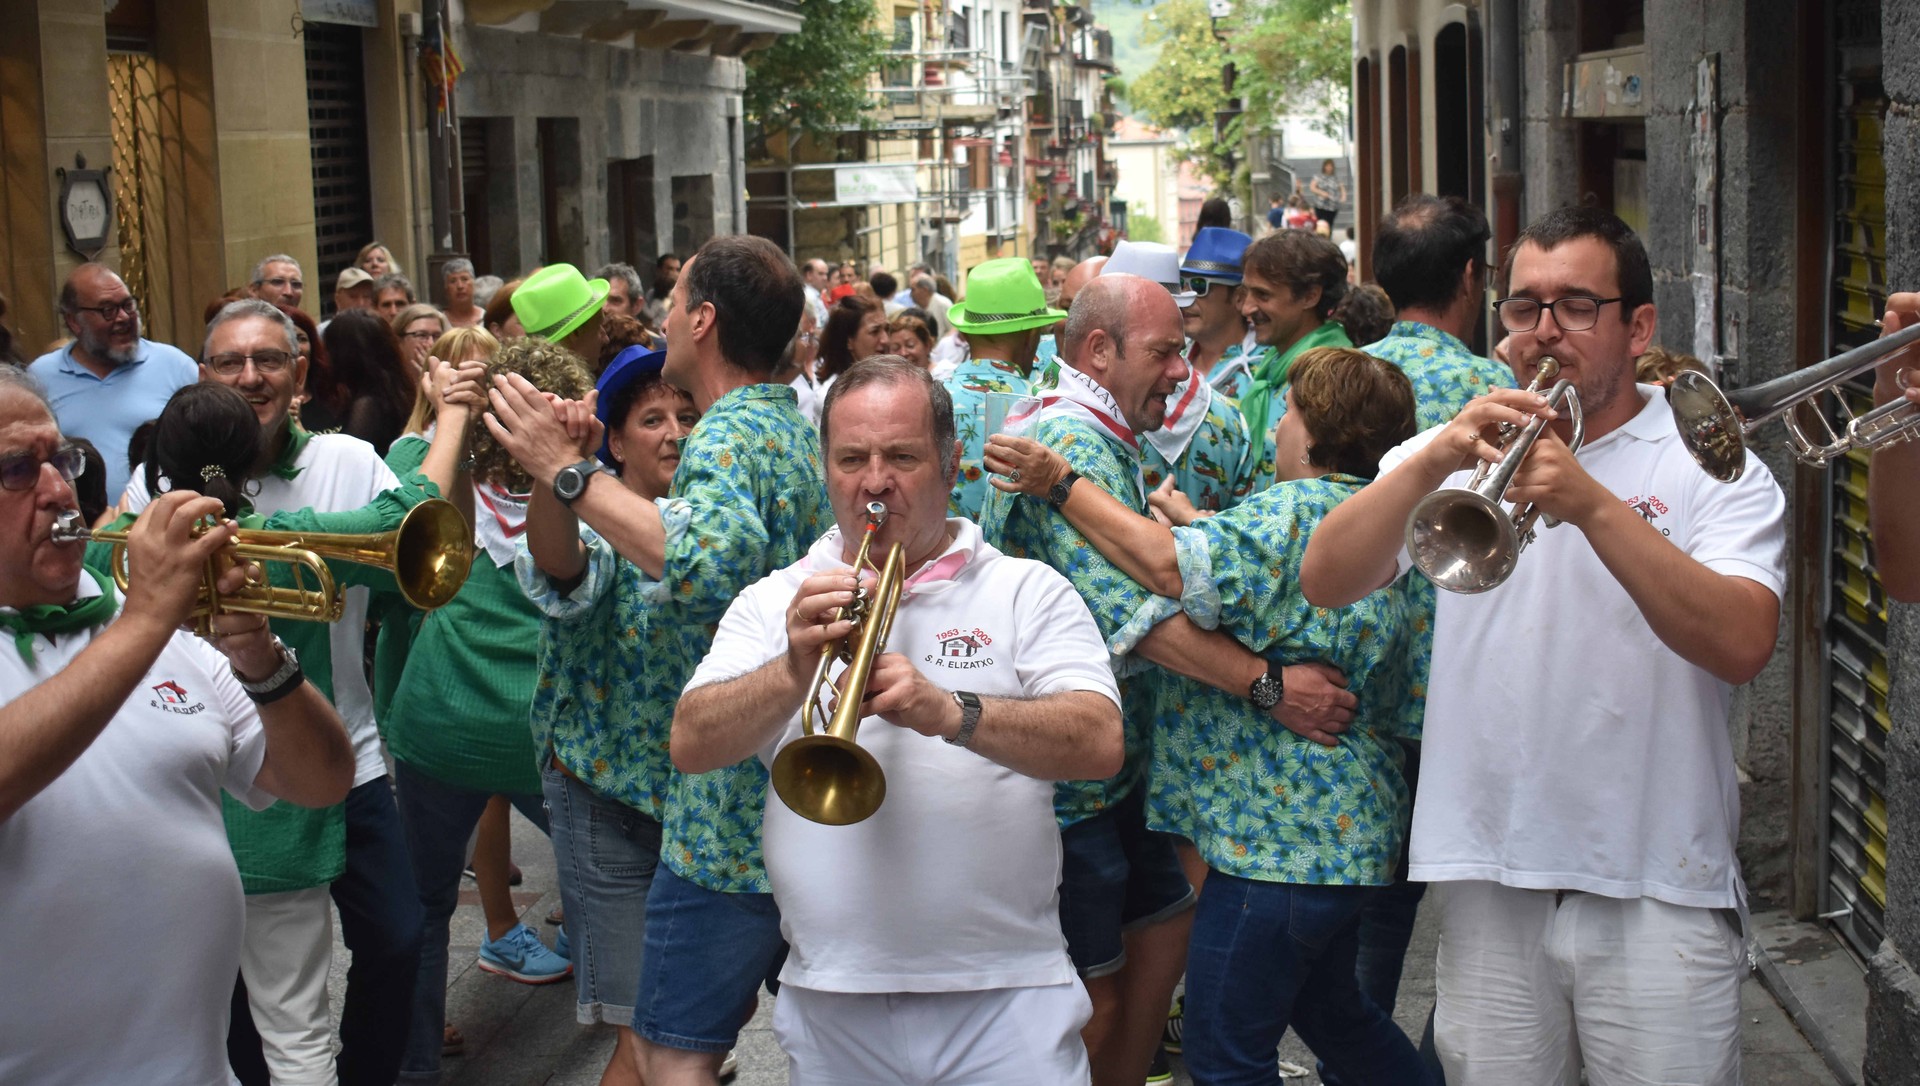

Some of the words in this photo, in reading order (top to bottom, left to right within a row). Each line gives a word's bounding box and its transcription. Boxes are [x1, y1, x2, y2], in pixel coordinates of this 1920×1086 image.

[1071, 371, 1120, 419] JAIAK
[1648, 495, 1669, 515] 2003
[936, 628, 959, 641] 1953
[971, 627, 993, 646] 2003
[924, 654, 933, 664] S.
[935, 658, 945, 667] R.
[947, 657, 994, 669] ELIZATXO
